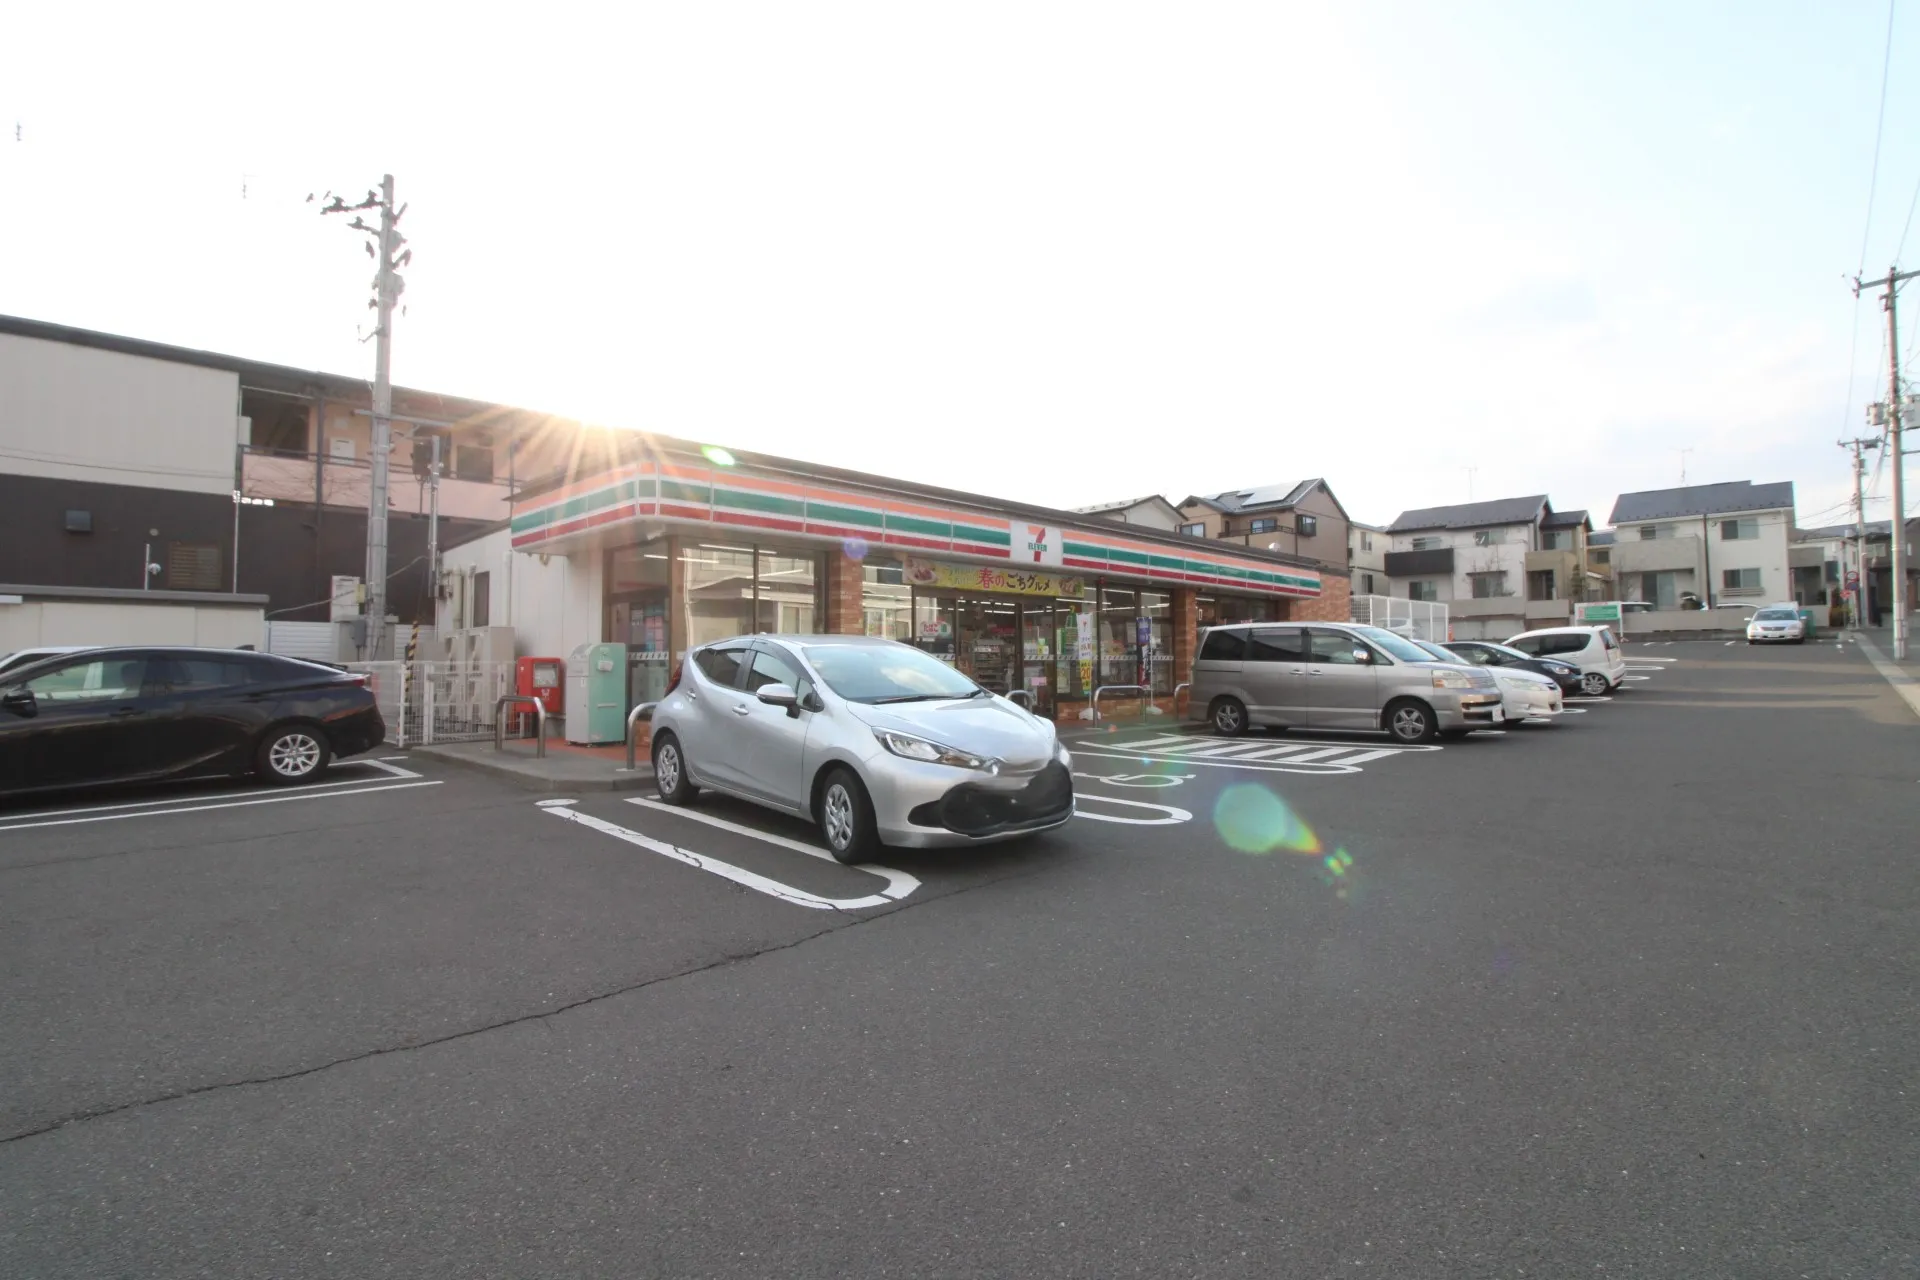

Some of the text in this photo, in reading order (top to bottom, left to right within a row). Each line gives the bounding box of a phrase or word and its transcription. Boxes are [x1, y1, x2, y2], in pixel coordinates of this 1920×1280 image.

[1027, 525, 1046, 562] 7
[978, 567, 1050, 592] 春のごちグルメ
